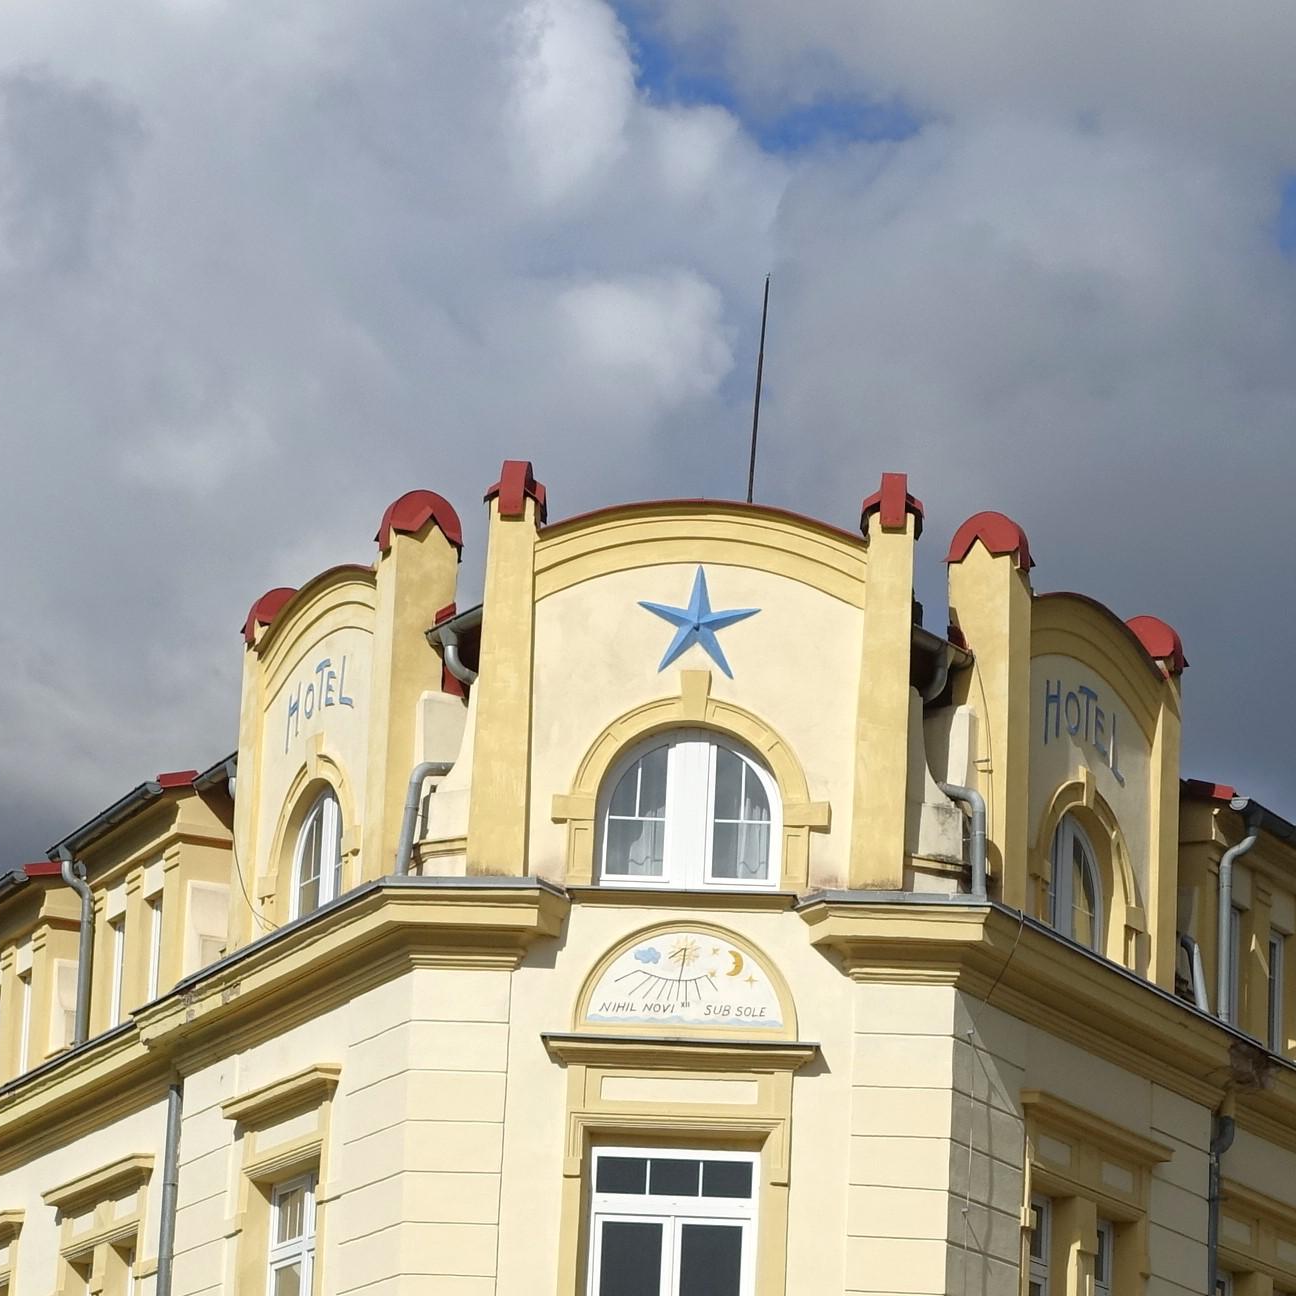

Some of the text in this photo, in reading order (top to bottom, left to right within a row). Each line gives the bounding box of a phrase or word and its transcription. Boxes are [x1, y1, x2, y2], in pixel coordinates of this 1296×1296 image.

[285, 655, 354, 755] HOTEL
[1044, 679, 1126, 788] HOTEL
[598, 1001, 766, 1017] NIHIL NOVI SUB SOLE
